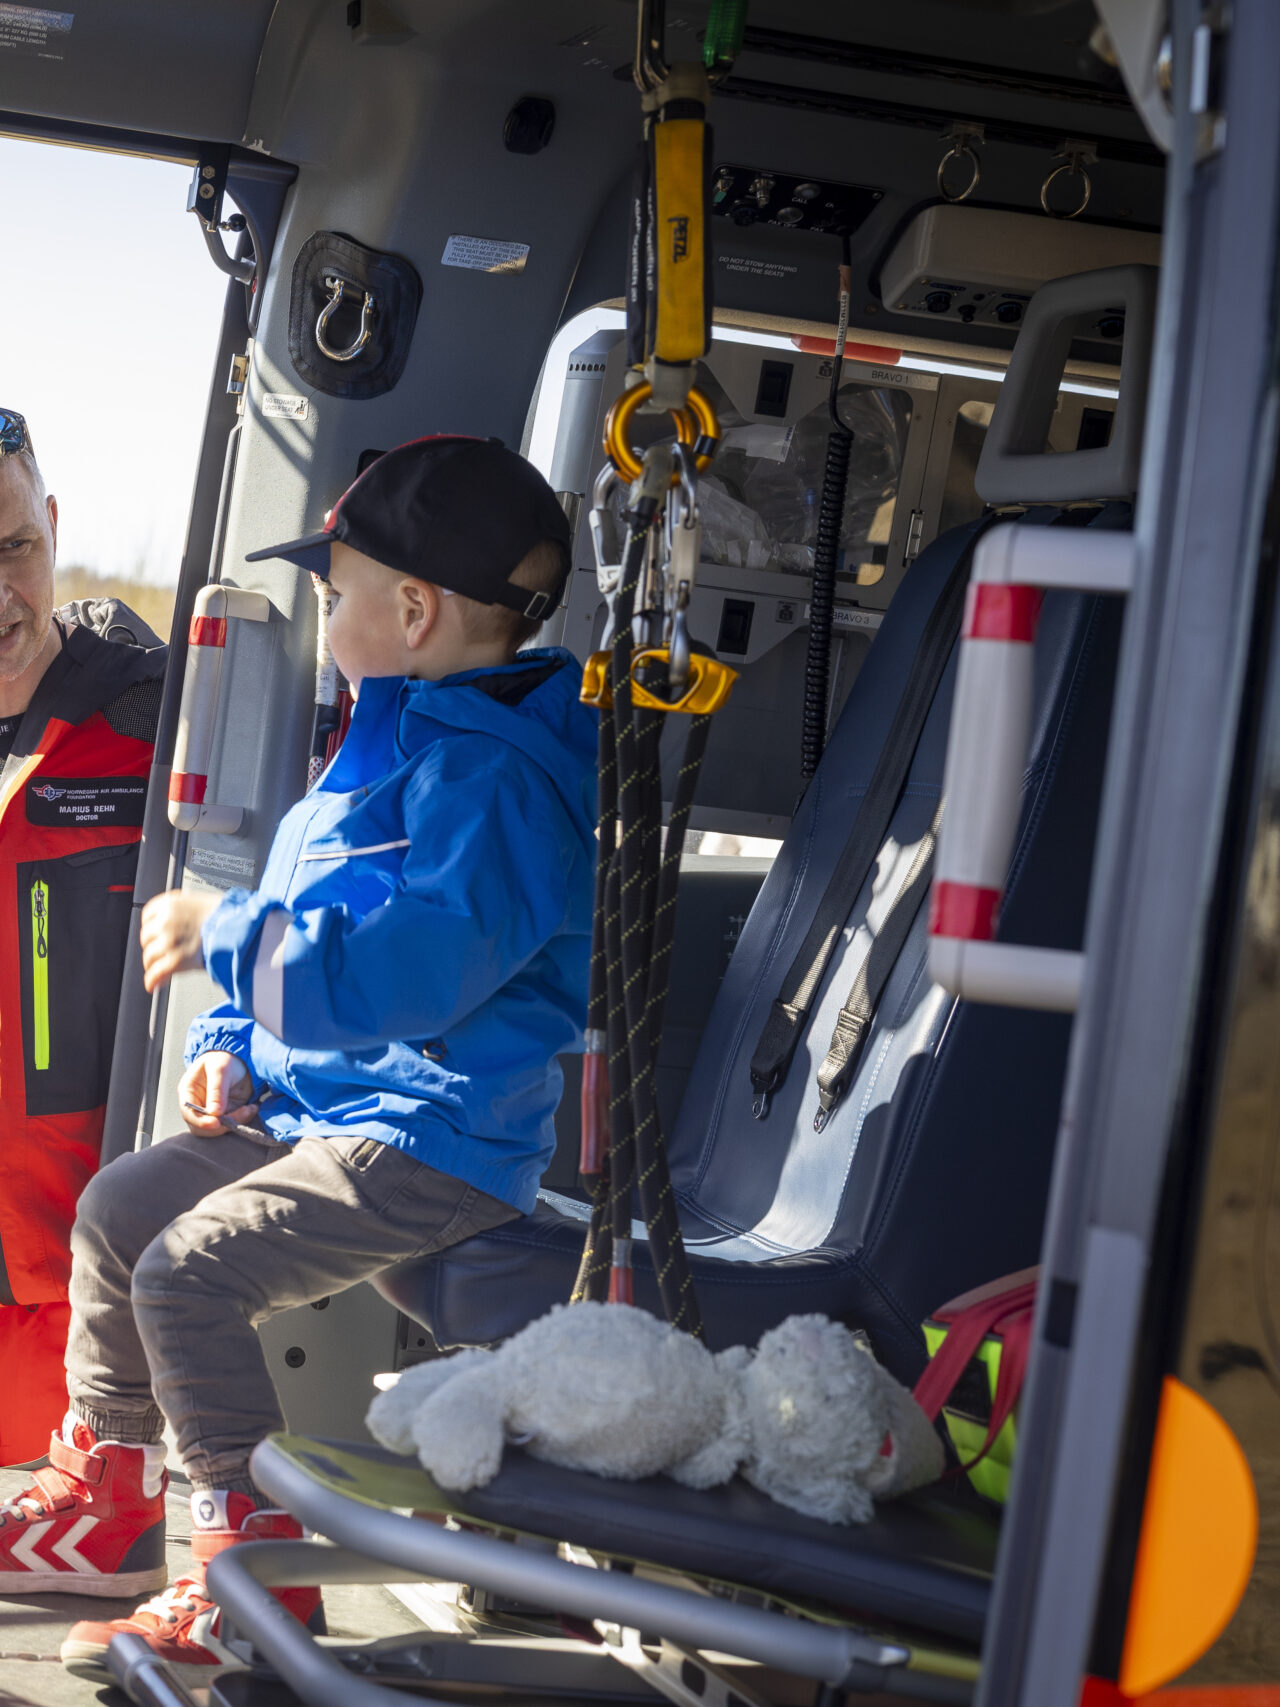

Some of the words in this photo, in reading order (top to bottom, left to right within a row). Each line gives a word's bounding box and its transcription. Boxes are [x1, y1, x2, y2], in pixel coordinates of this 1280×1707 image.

[26, 37, 47, 45] LENGTH
[726, 264, 749, 272] UNDER
[745, 259, 764, 267] STOW
[764, 263, 798, 272] ANYTHING
[872, 370, 903, 383] BRAVO
[833, 611, 862, 624] BRAVO
[863, 617, 870, 625] 3
[59, 805, 90, 813] MARIUS
[93, 805, 116, 813] REHN
